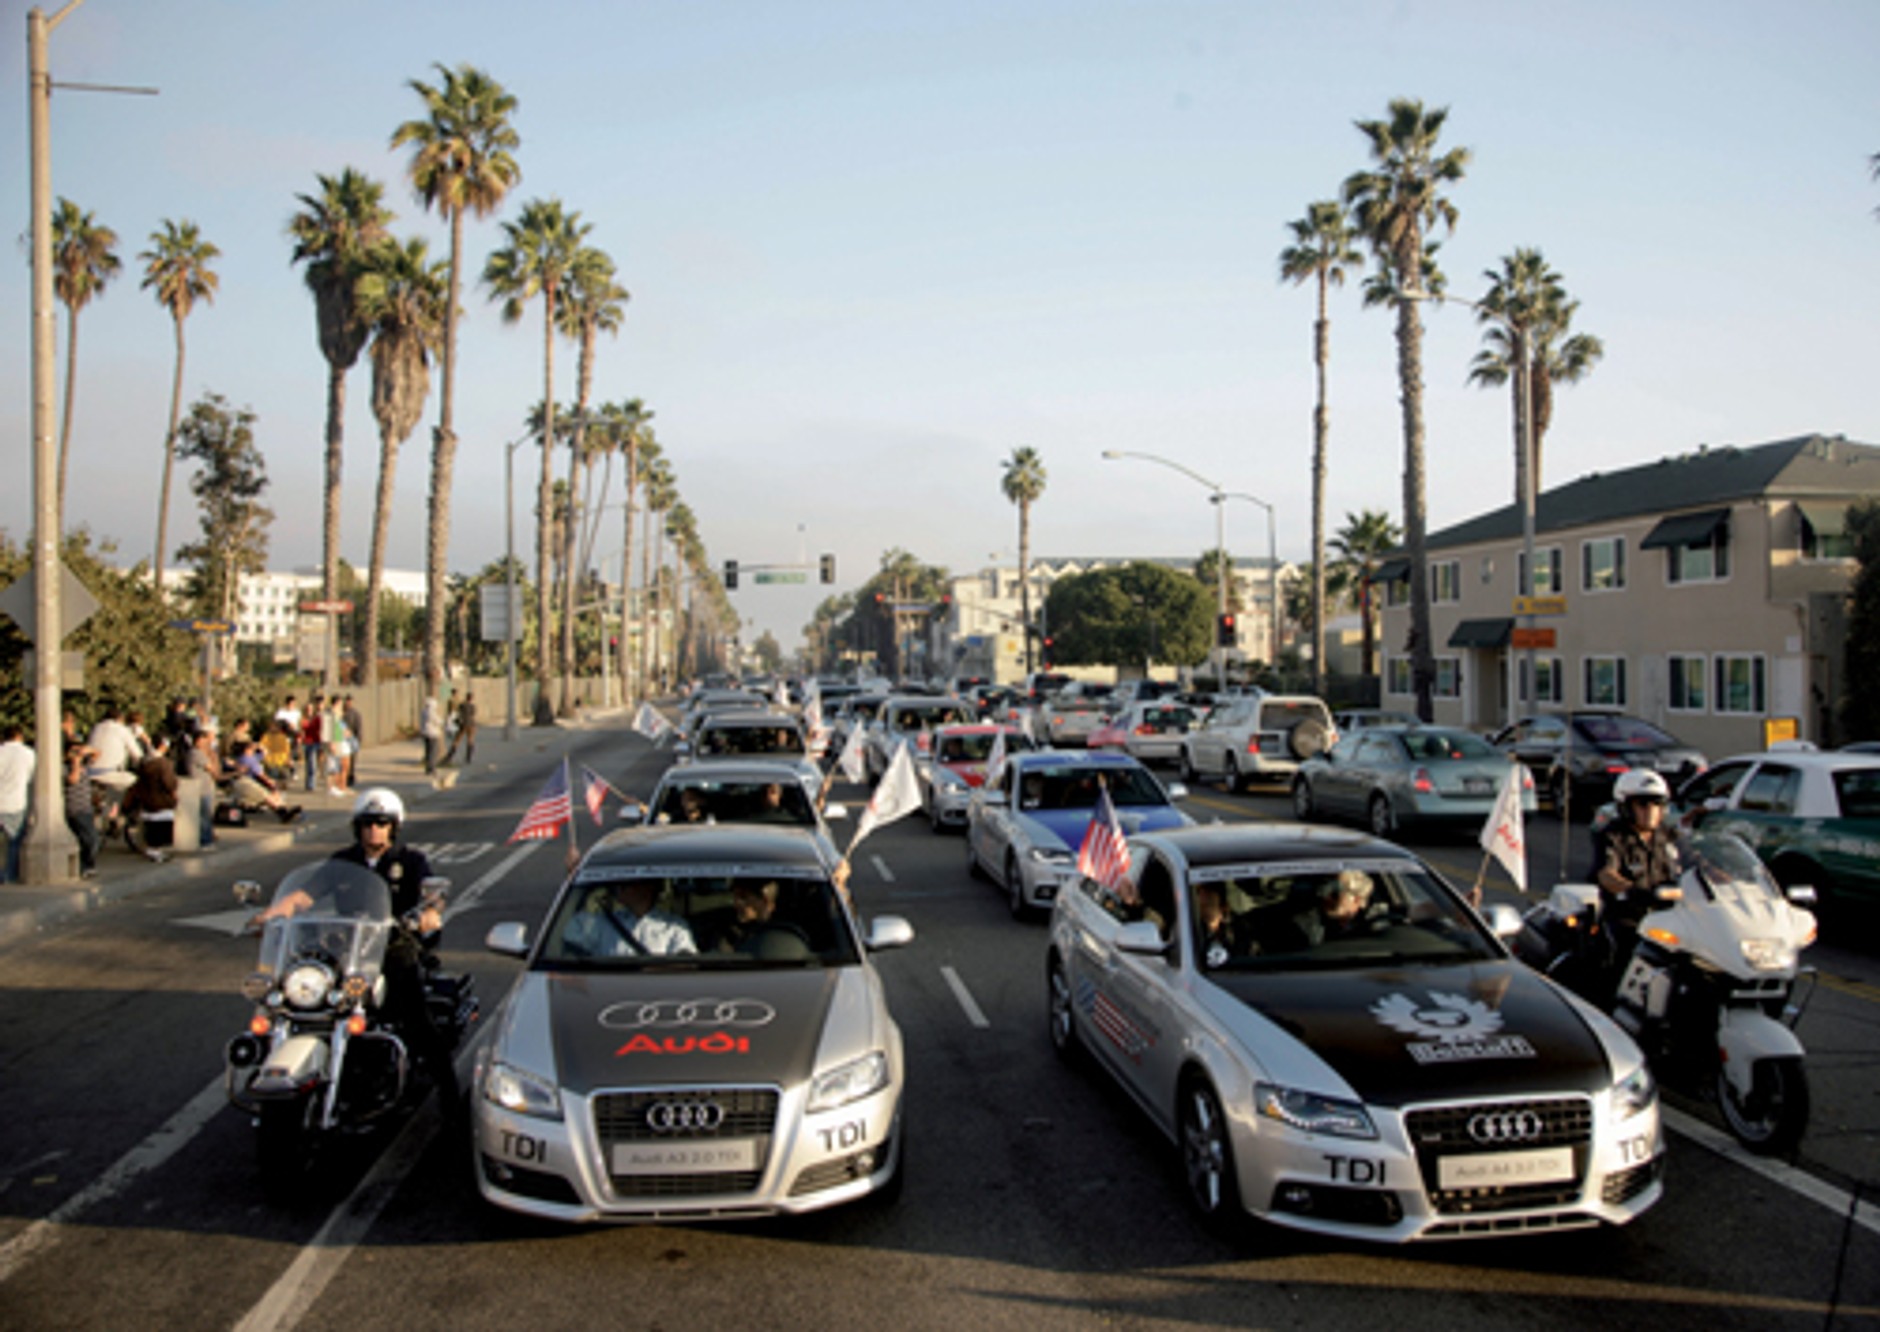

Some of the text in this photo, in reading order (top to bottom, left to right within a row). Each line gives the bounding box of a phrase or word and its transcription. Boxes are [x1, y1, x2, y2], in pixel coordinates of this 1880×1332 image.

[500, 1129, 547, 1164] TDI
[816, 1118, 867, 1153] TDI
[1323, 1154, 1386, 1186] TDI
